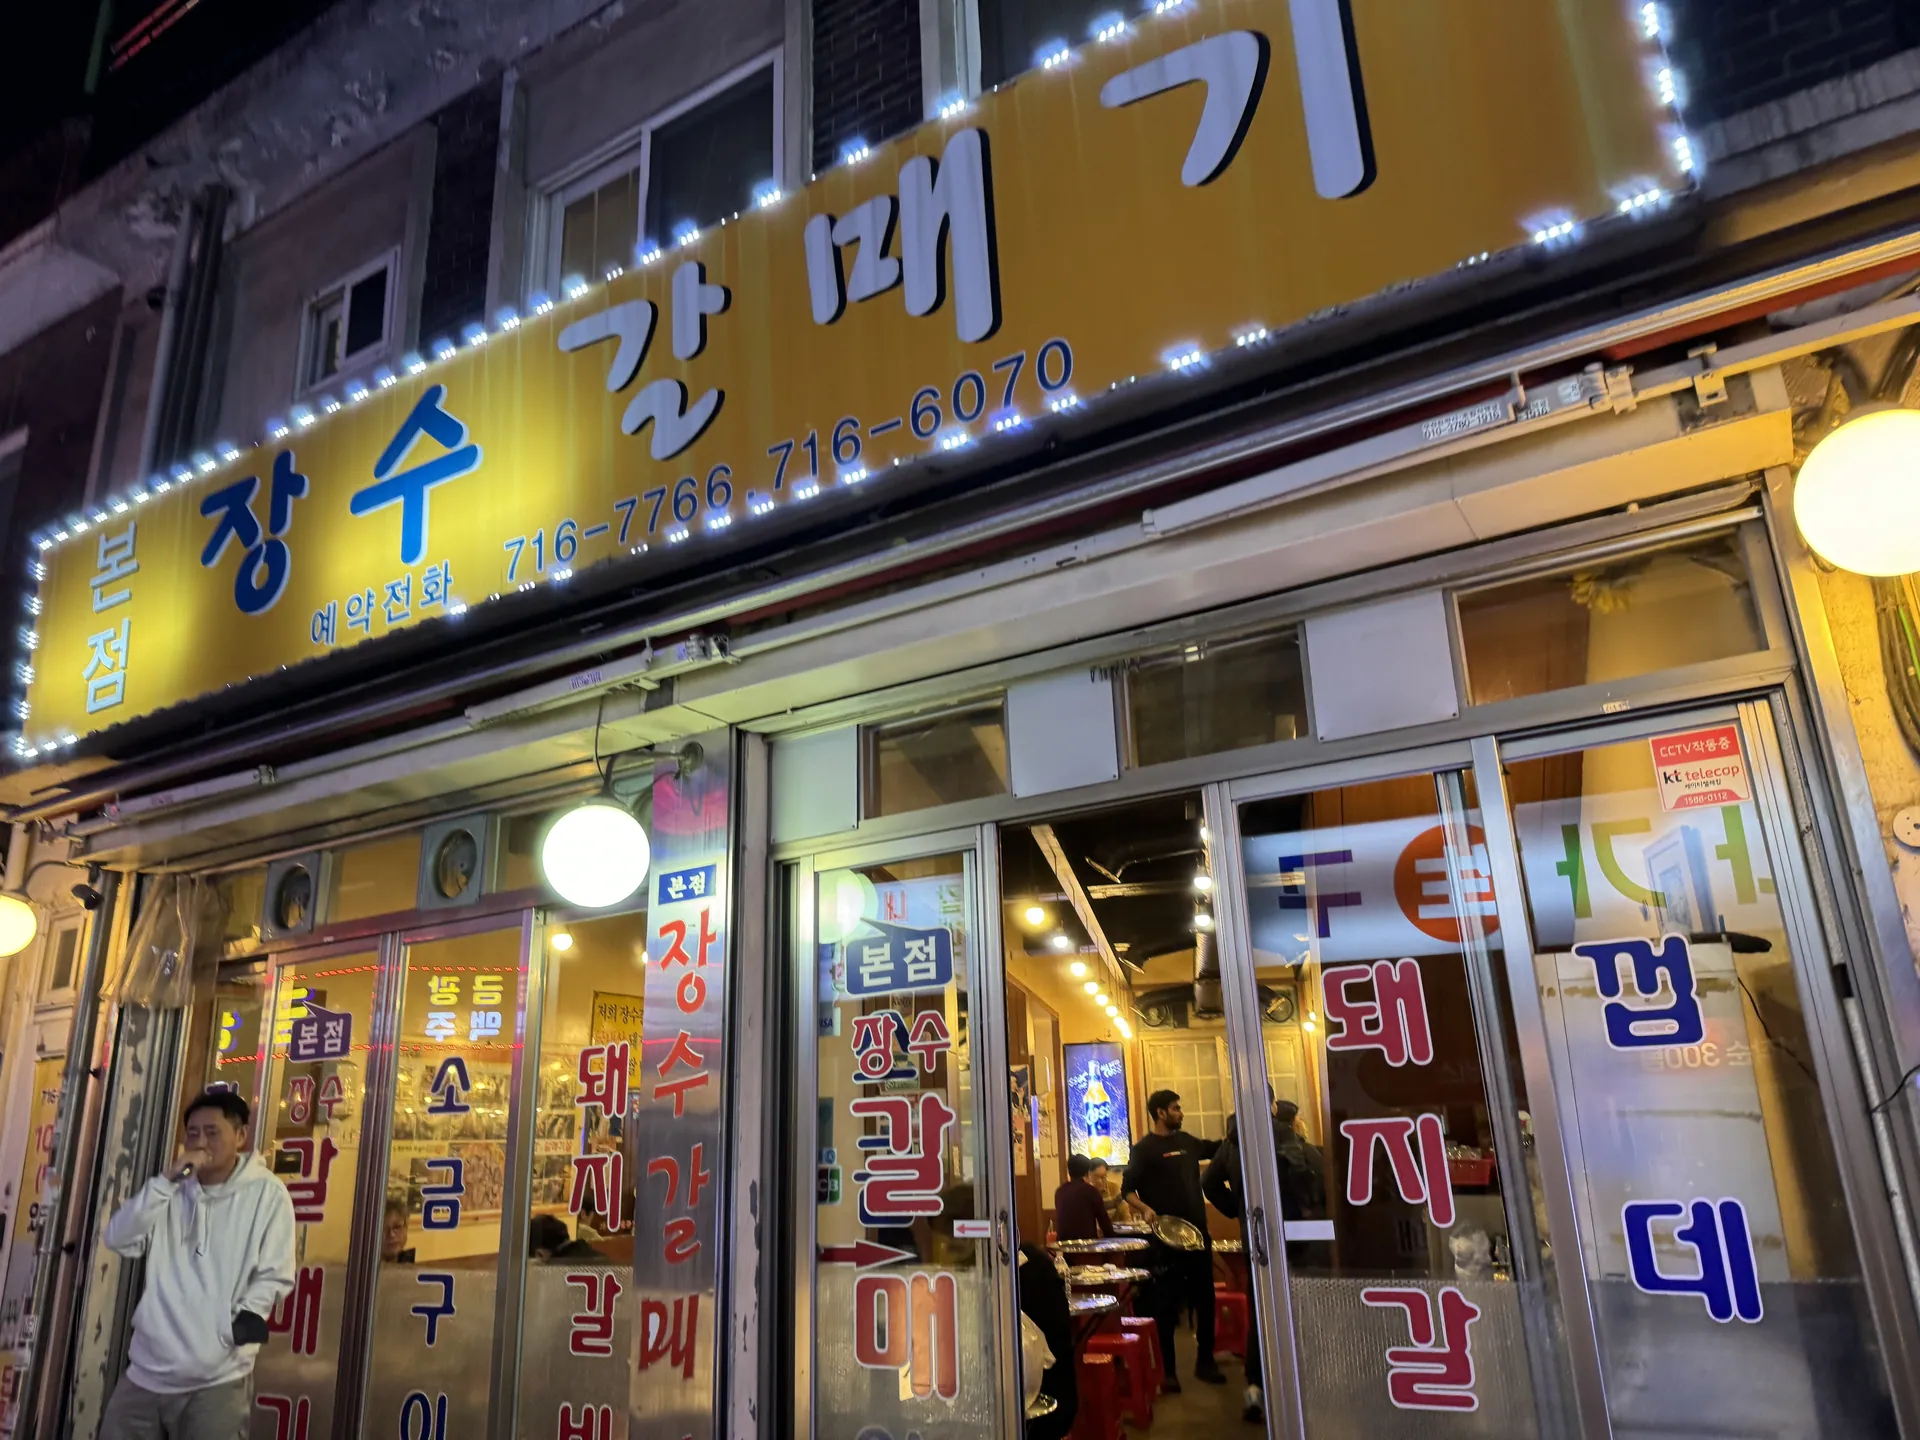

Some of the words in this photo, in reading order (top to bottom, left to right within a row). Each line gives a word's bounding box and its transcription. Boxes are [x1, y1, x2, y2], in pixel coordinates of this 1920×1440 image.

[82, 521, 139, 714] 본점
[310, 560, 454, 646] 예약전화
[1663, 769, 1683, 785] kt
[1685, 763, 1740, 783] telecop
[666, 872, 708, 901] 본점
[857, 934, 938, 986] 본점
[298, 1018, 344, 1056] 본점
[851, 1010, 951, 1078] 장수
[289, 1074, 345, 1124] 장수
[636, 907, 717, 1440] 장수갈매
